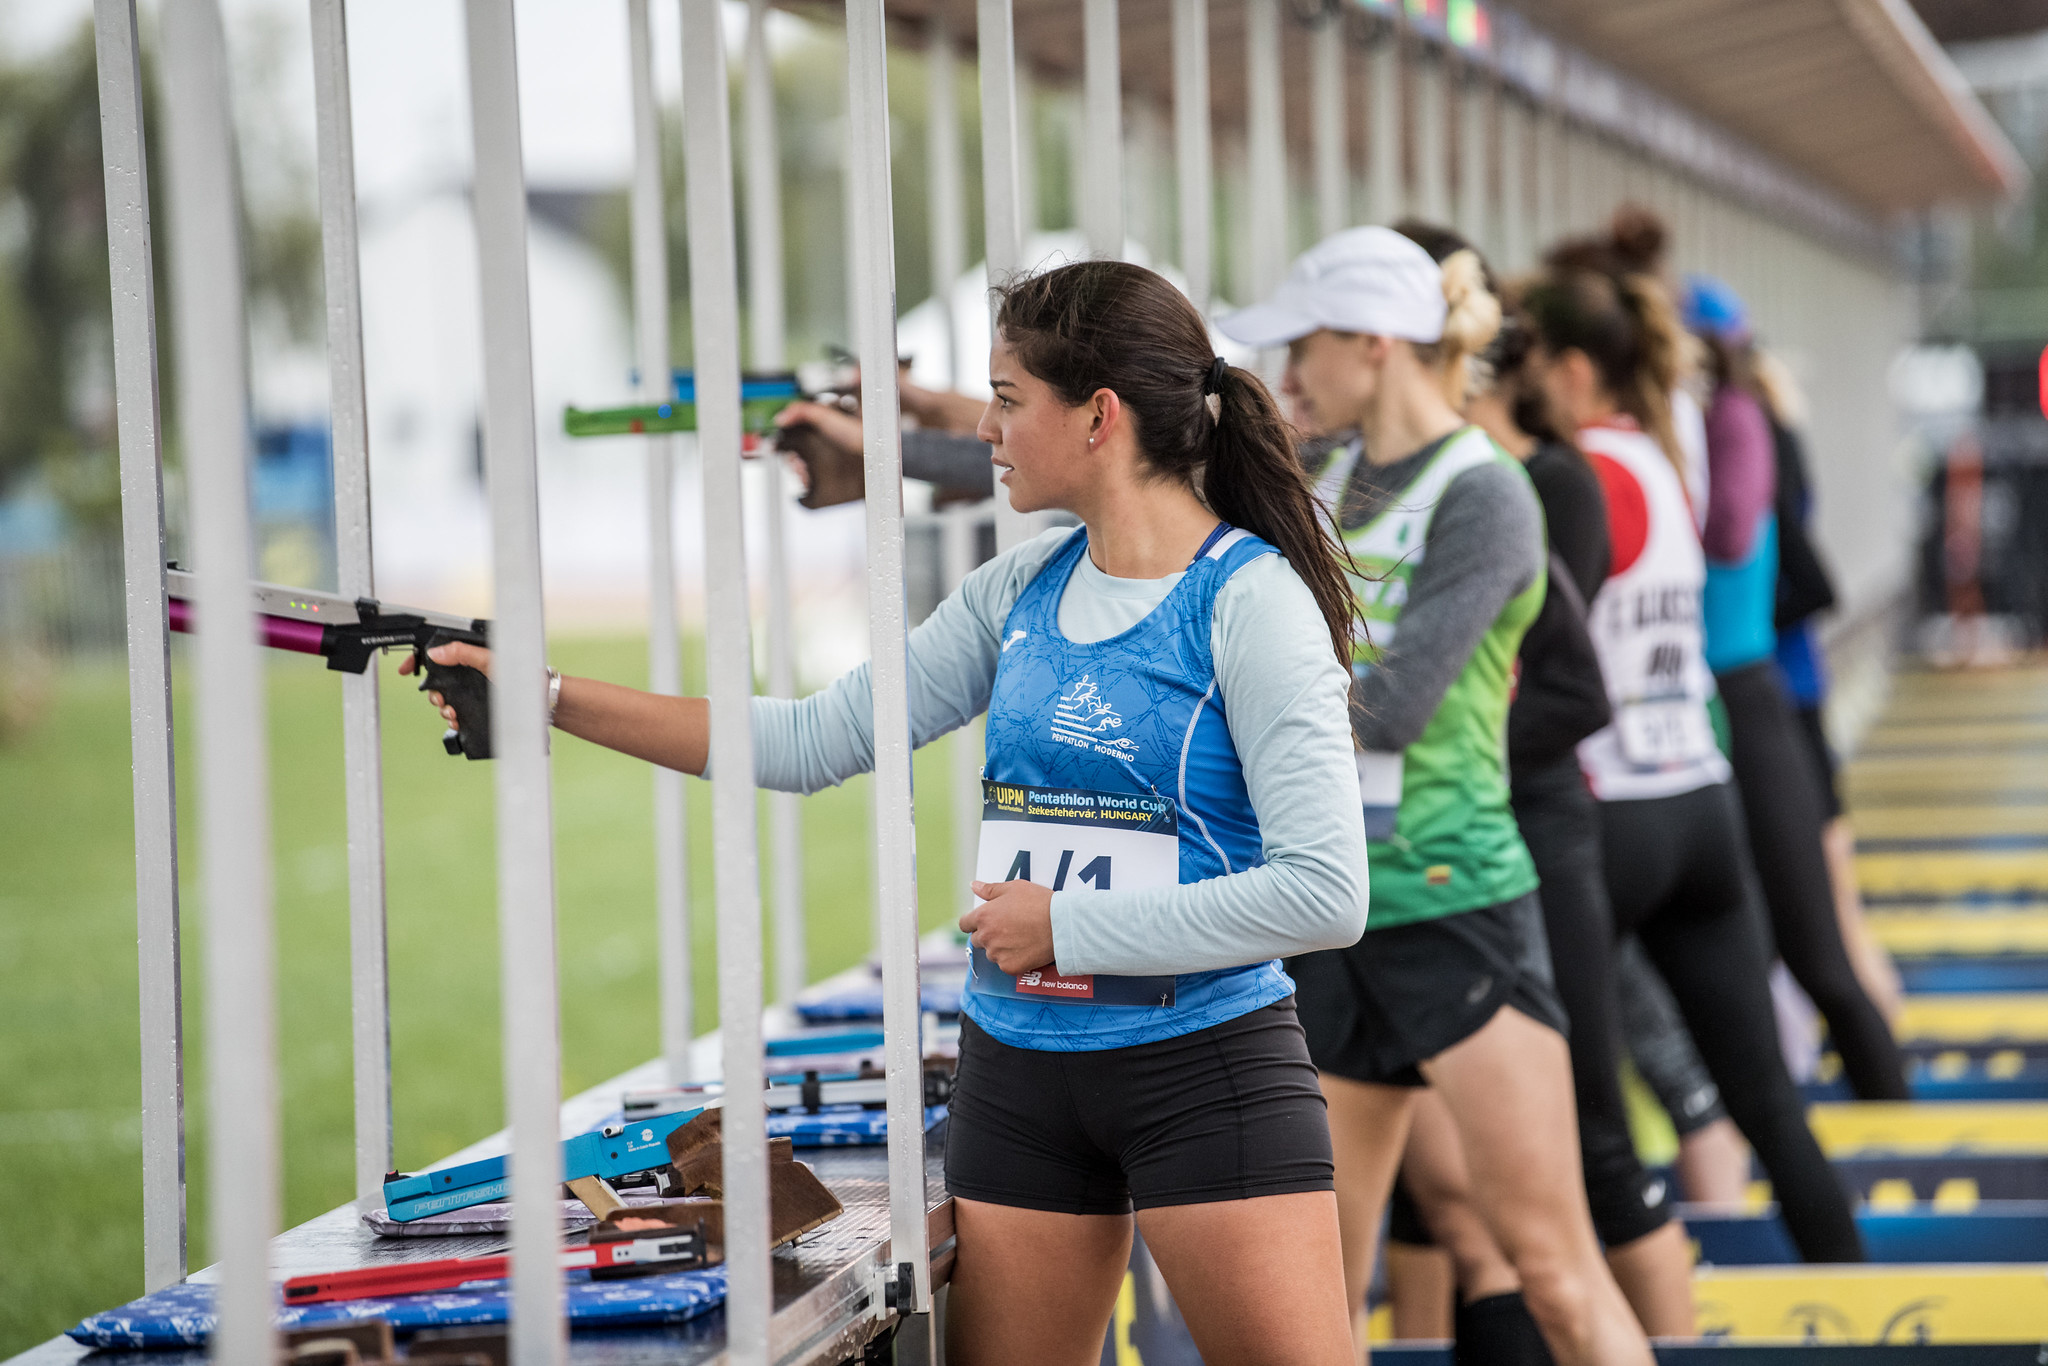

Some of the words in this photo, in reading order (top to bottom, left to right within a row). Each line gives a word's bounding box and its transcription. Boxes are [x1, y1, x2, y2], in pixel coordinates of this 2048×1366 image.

[1051, 732, 1090, 749] PENTATLON
[1094, 744, 1135, 762] MODERNO
[996, 786, 1024, 806] UIPM
[1028, 790, 1094, 806] Pentathlon
[1097, 795, 1138, 809] World
[1140, 800, 1167, 814] Cup
[1027, 804, 1098, 819] Székesfehérvár,
[1100, 809, 1153, 821] HUNGARY
[1056, 981, 1088, 990] balance
